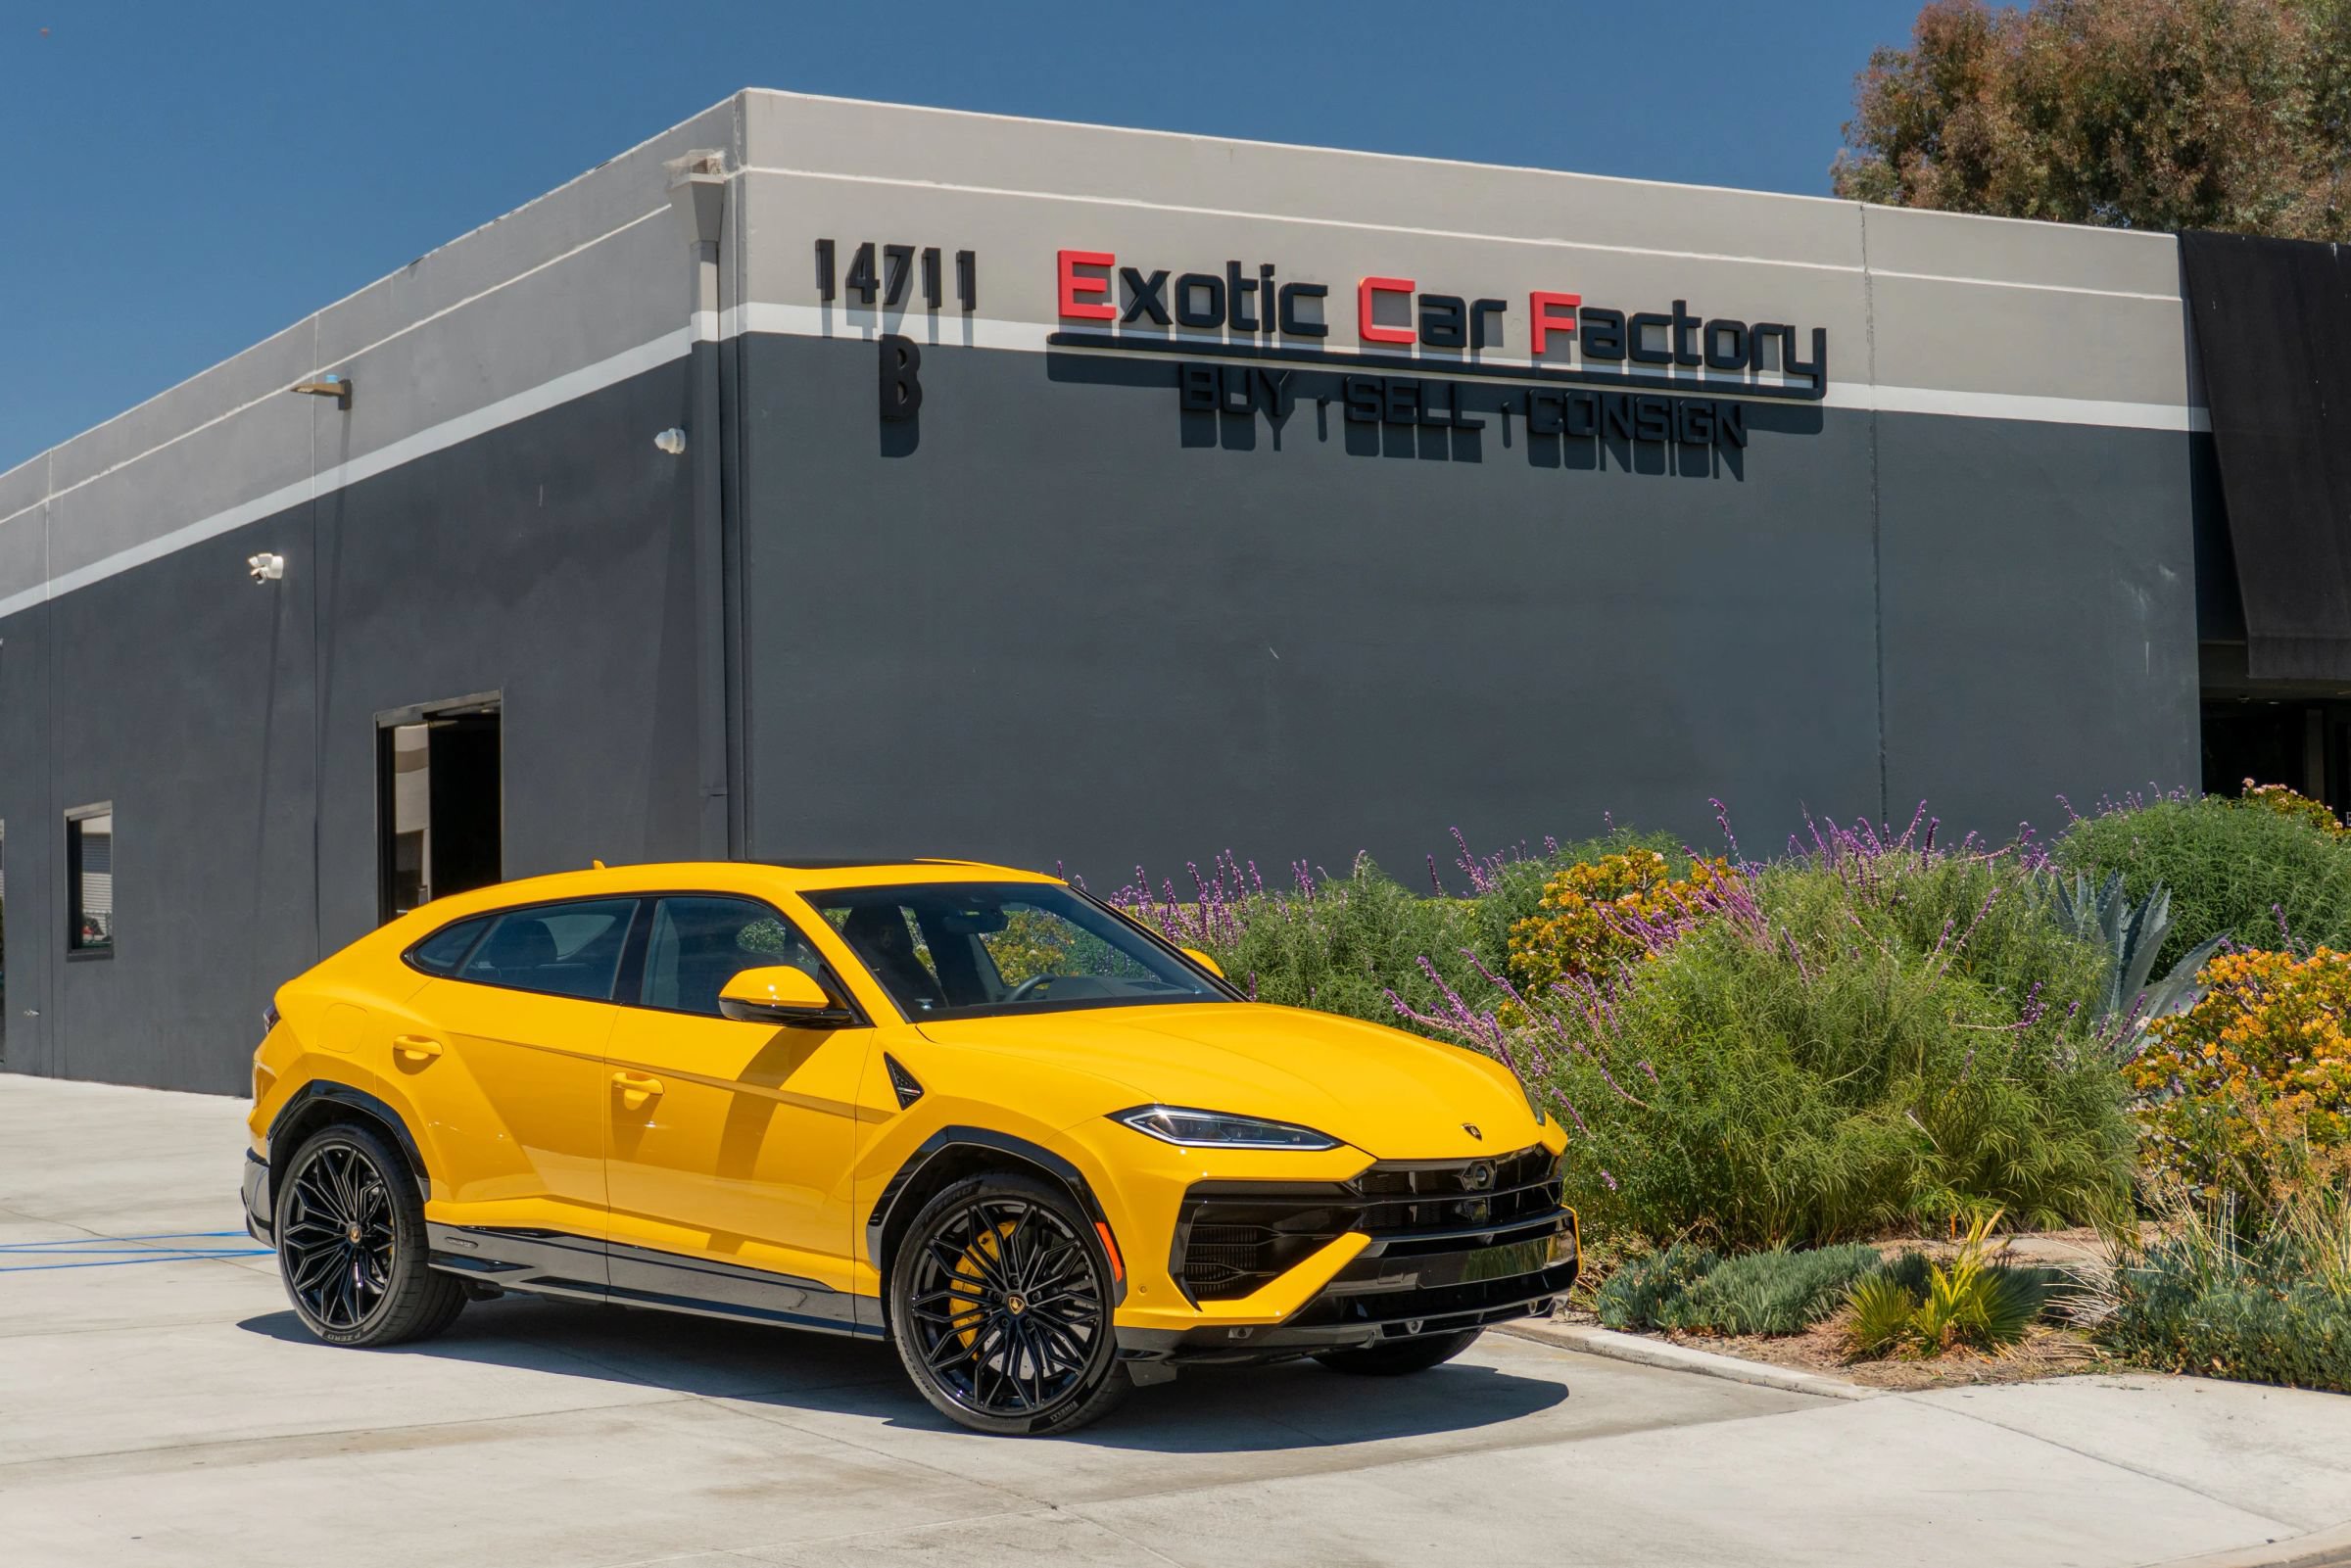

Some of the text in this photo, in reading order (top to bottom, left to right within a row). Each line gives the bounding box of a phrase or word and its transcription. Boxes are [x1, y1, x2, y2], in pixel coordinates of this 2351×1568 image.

[815, 238, 976, 311] 14711
[1057, 249, 1827, 400] Exotic Car Factory
[879, 334, 922, 423] B
[1178, 362, 1748, 448] BUY SELL CONSIGN
